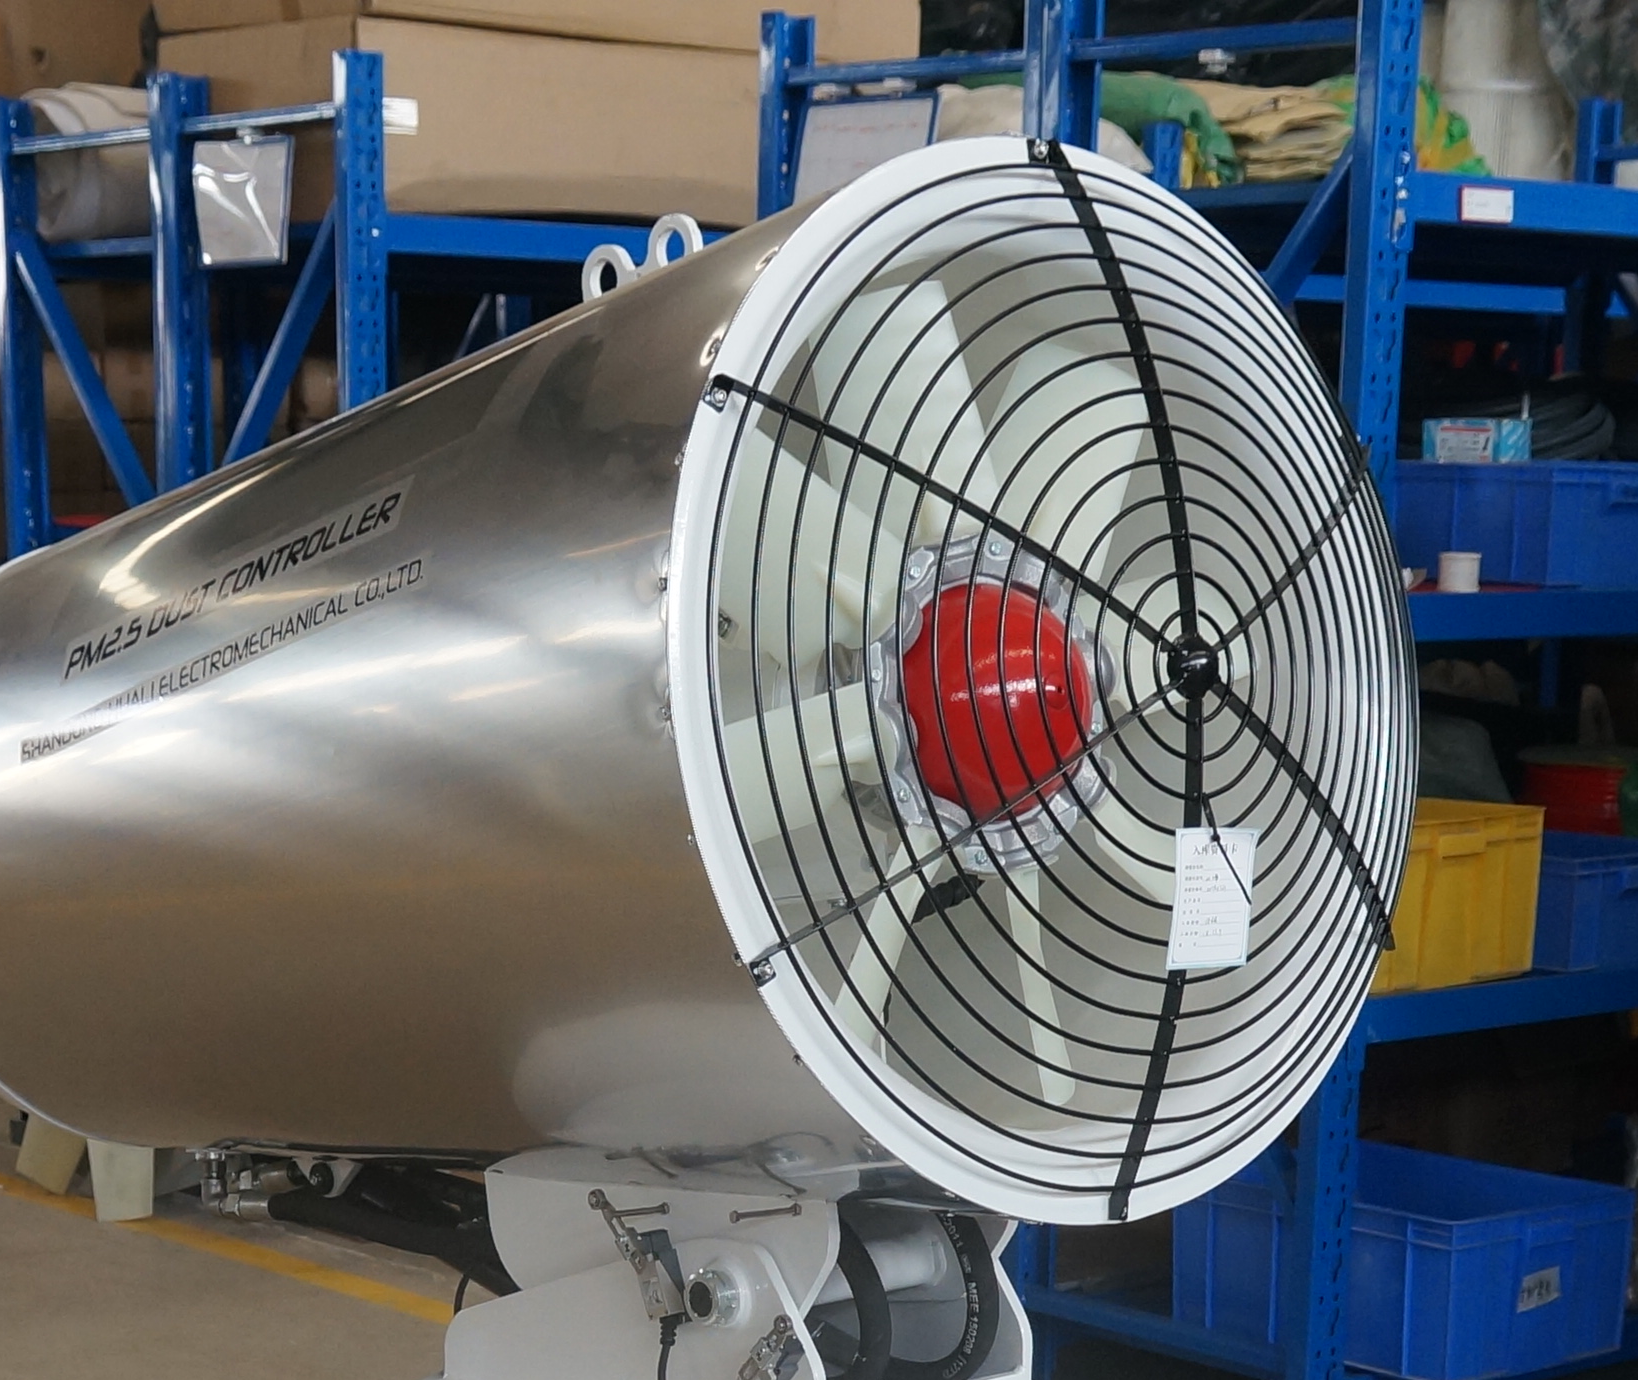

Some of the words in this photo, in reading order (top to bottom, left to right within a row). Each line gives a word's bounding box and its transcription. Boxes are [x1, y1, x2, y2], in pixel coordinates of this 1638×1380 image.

[64, 616, 143, 680] PM2.5
[146, 578, 217, 638] DUST
[216, 492, 402, 603] CONTROLLER
[159, 594, 349, 698] ELECTROMECHANICAL
